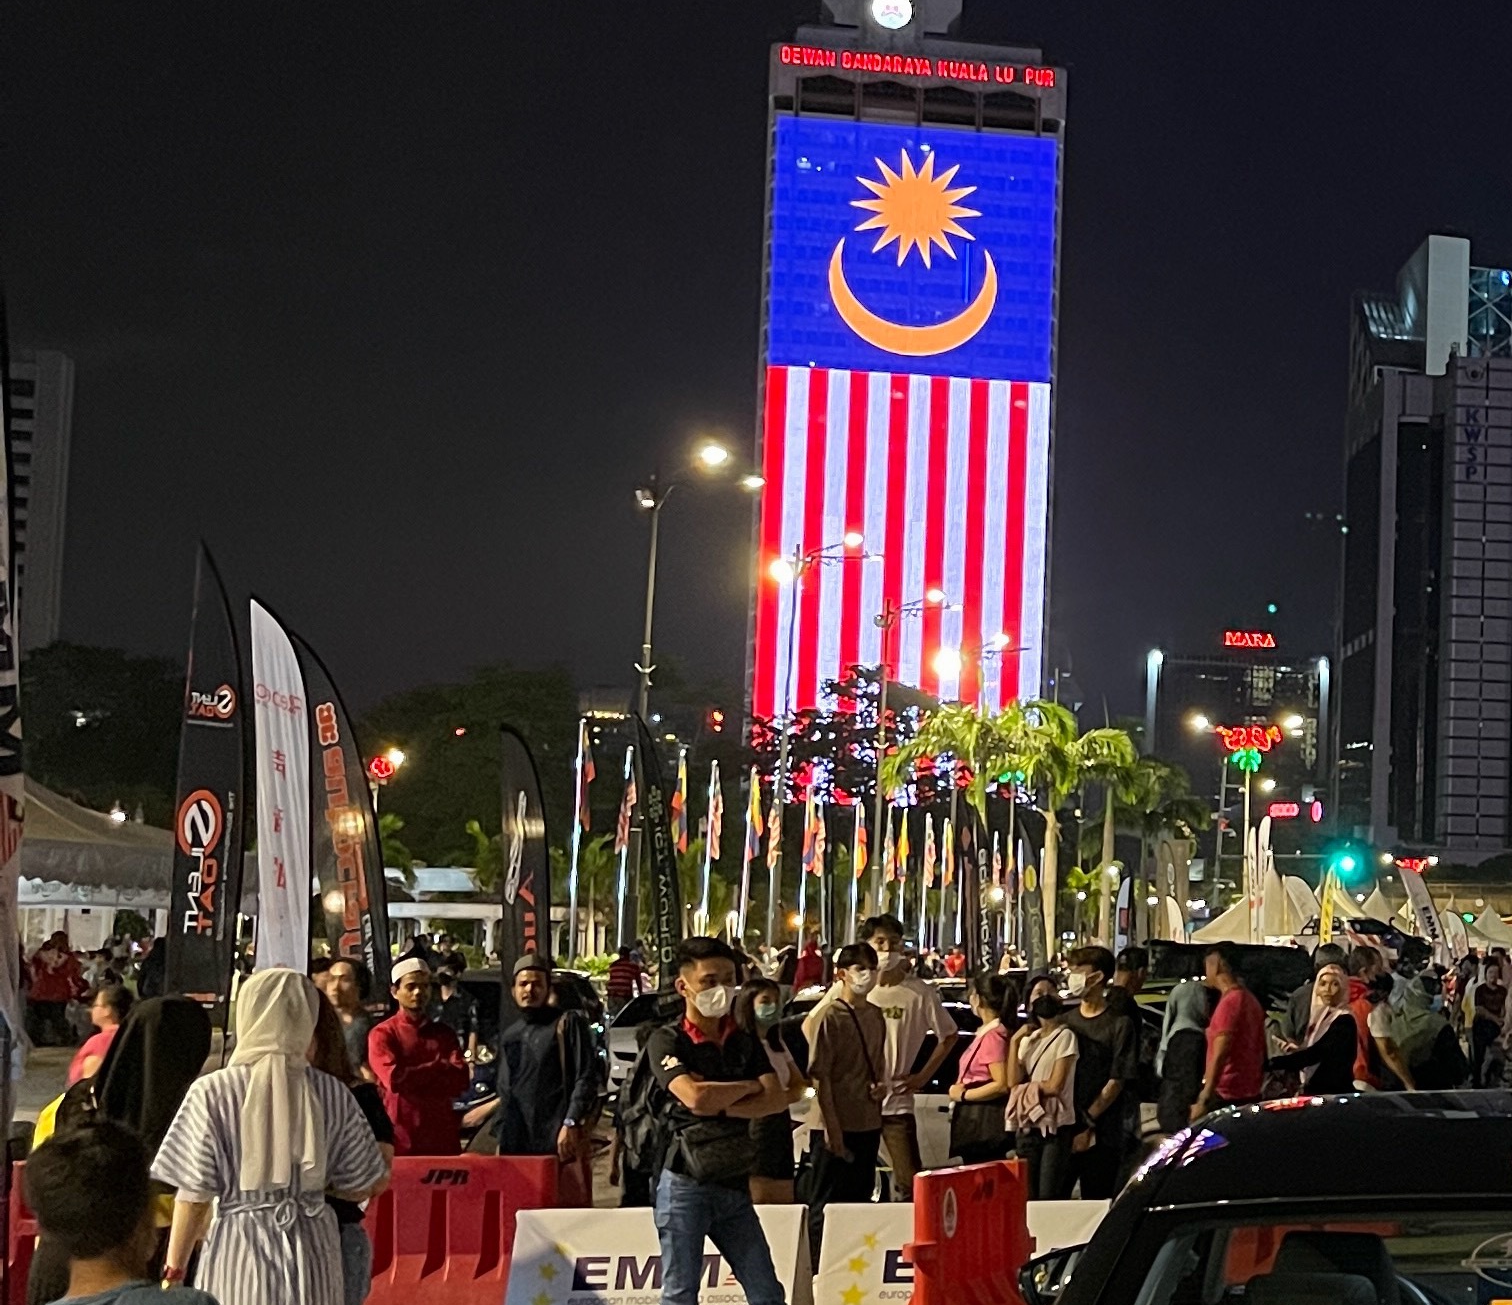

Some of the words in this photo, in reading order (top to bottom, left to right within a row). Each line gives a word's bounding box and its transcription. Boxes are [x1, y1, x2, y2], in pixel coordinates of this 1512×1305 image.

[780, 45, 837, 67] DEWAN
[841, 50, 932, 77] BANDARAYA
[937, 59, 989, 82] KUALA
[995, 65, 1055, 87] LUPUR
[1224, 631, 1276, 648] MARA
[879, 1287, 913, 1301] europ
